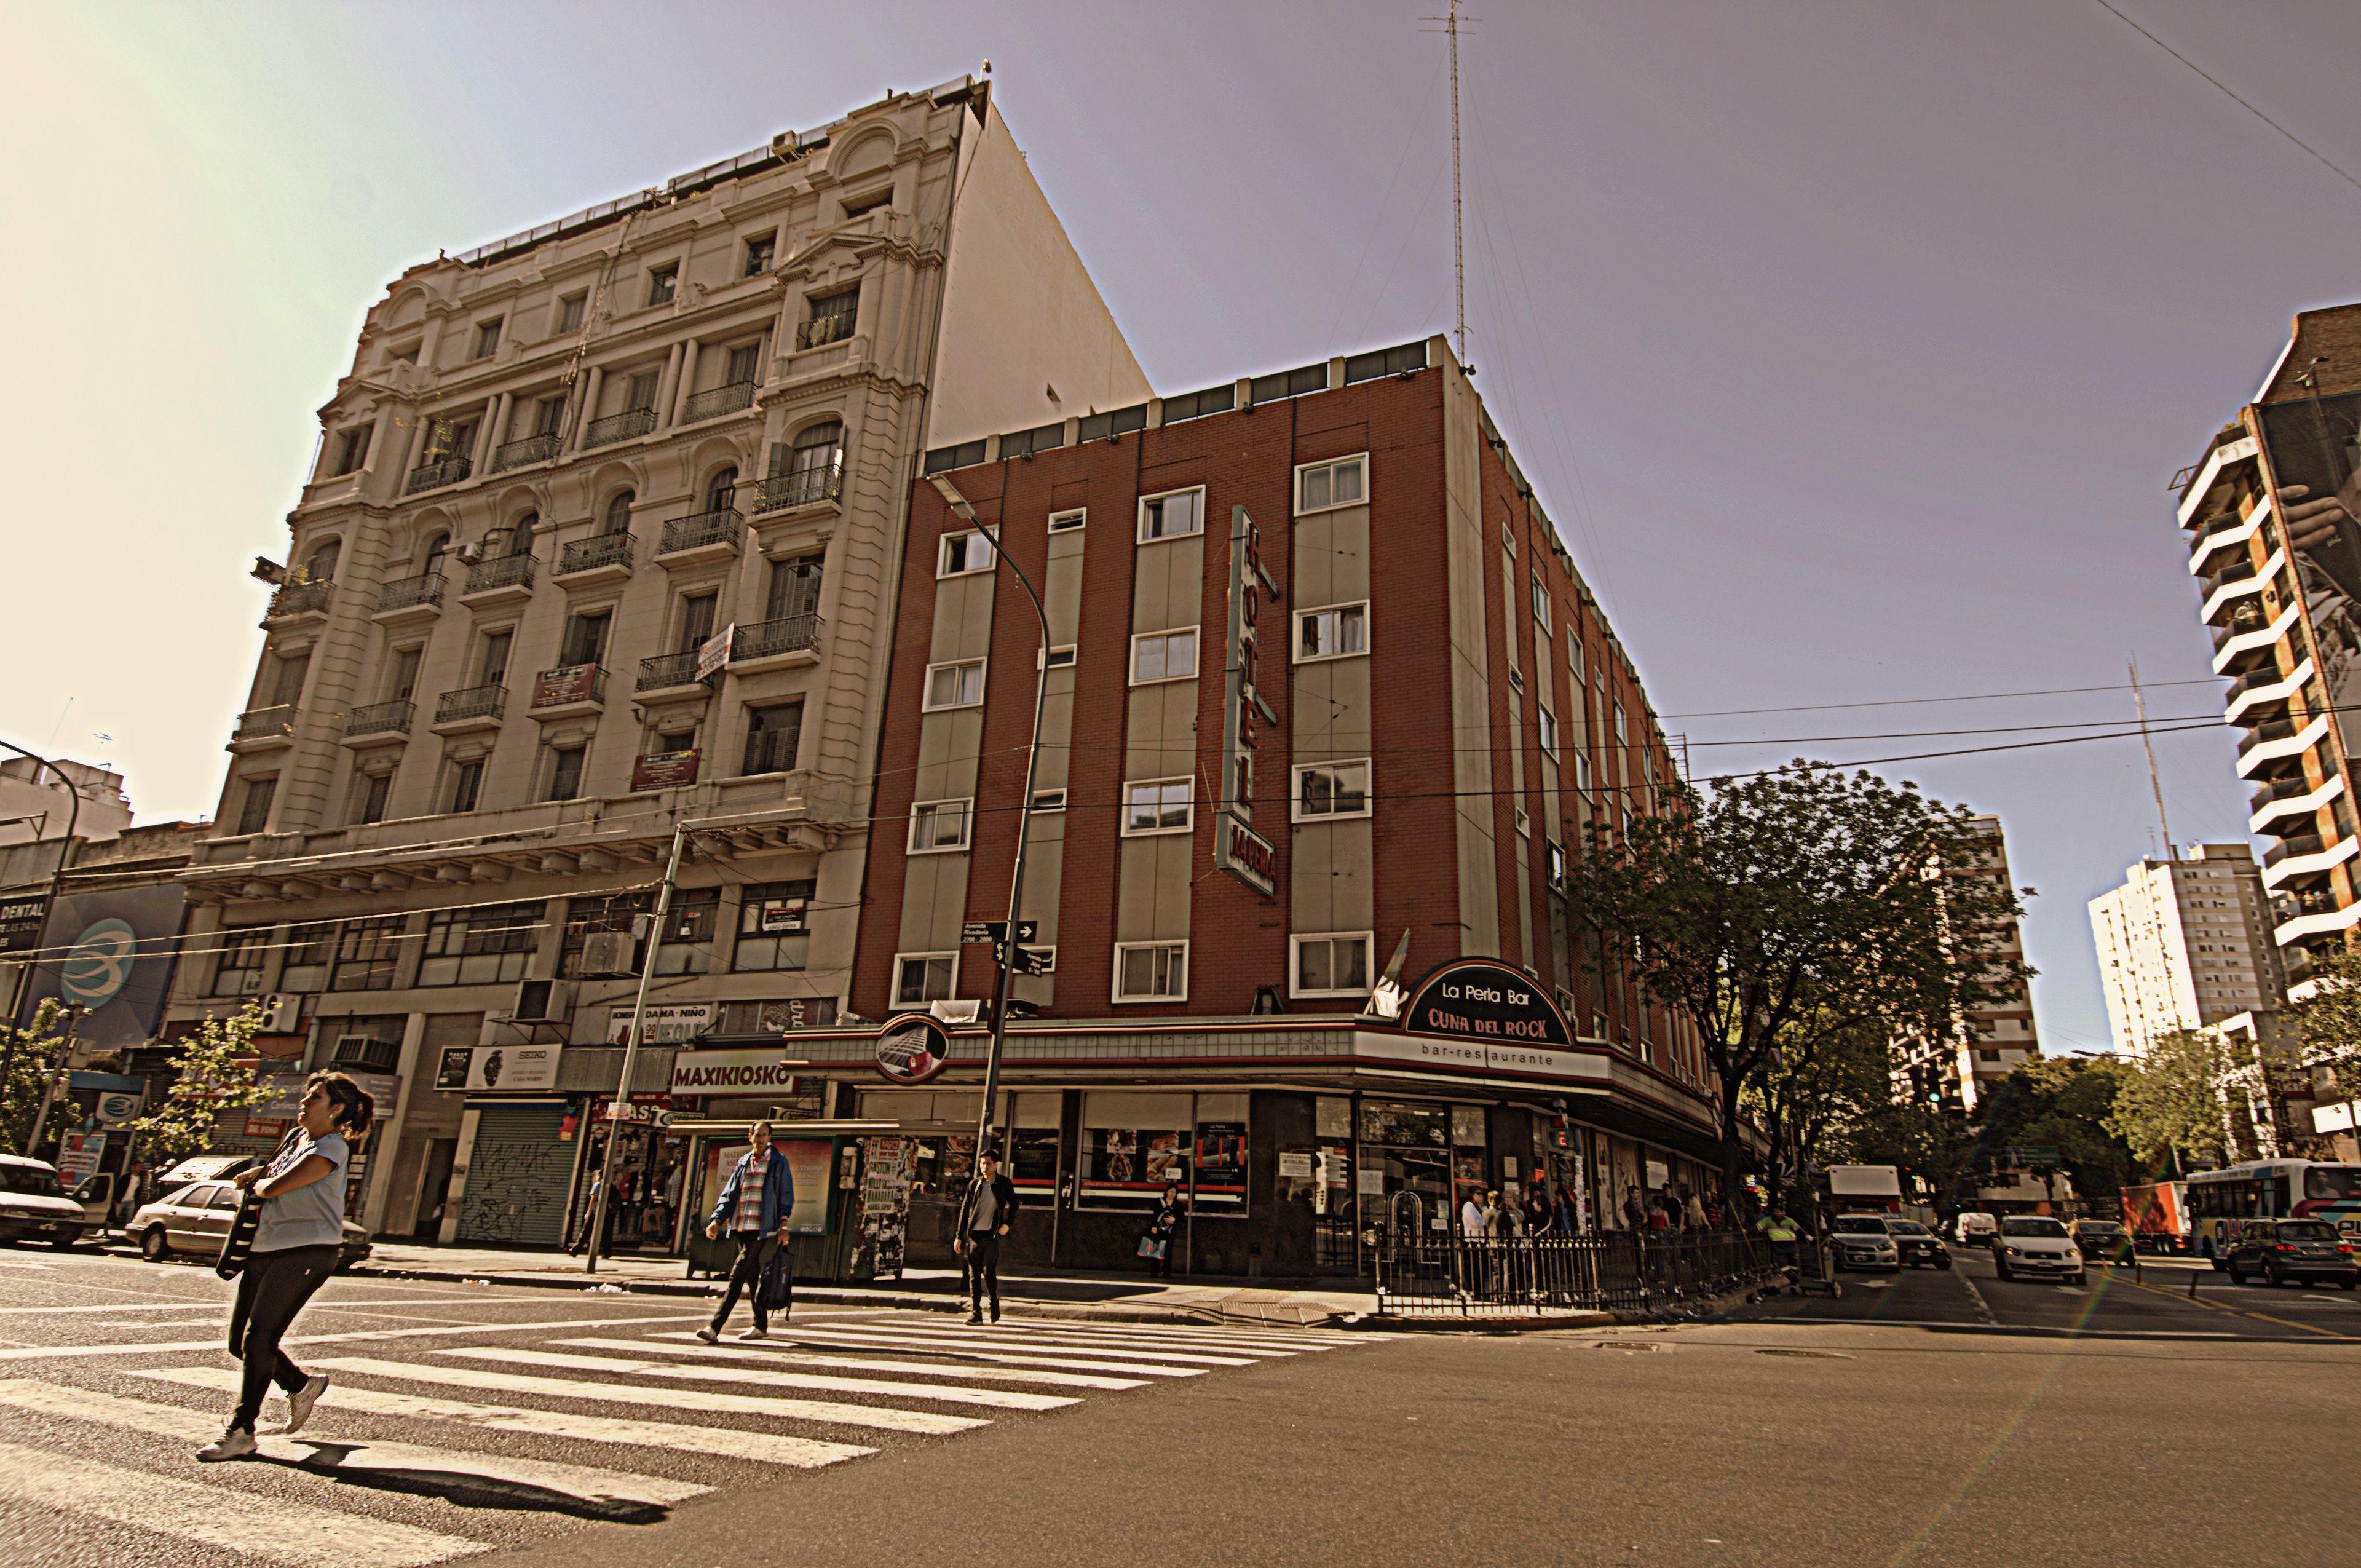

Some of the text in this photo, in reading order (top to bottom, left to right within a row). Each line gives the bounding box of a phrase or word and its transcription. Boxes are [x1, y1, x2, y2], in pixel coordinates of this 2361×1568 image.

[1241, 523, 1260, 809] HOTEL
[1232, 825, 1275, 881] LA PERLA
[1, 903, 44, 919] DENTAL
[1442, 983, 1530, 1006] La Perla Bar
[646, 1010, 675, 1018] DAMA
[680, 1007, 706, 1018] NIÑO
[1428, 1008, 1548, 1039] CUNA DEL ROCK
[518, 1051, 547, 1059] SEIKO
[674, 1066, 790, 1087] MAXIKIOSKO
